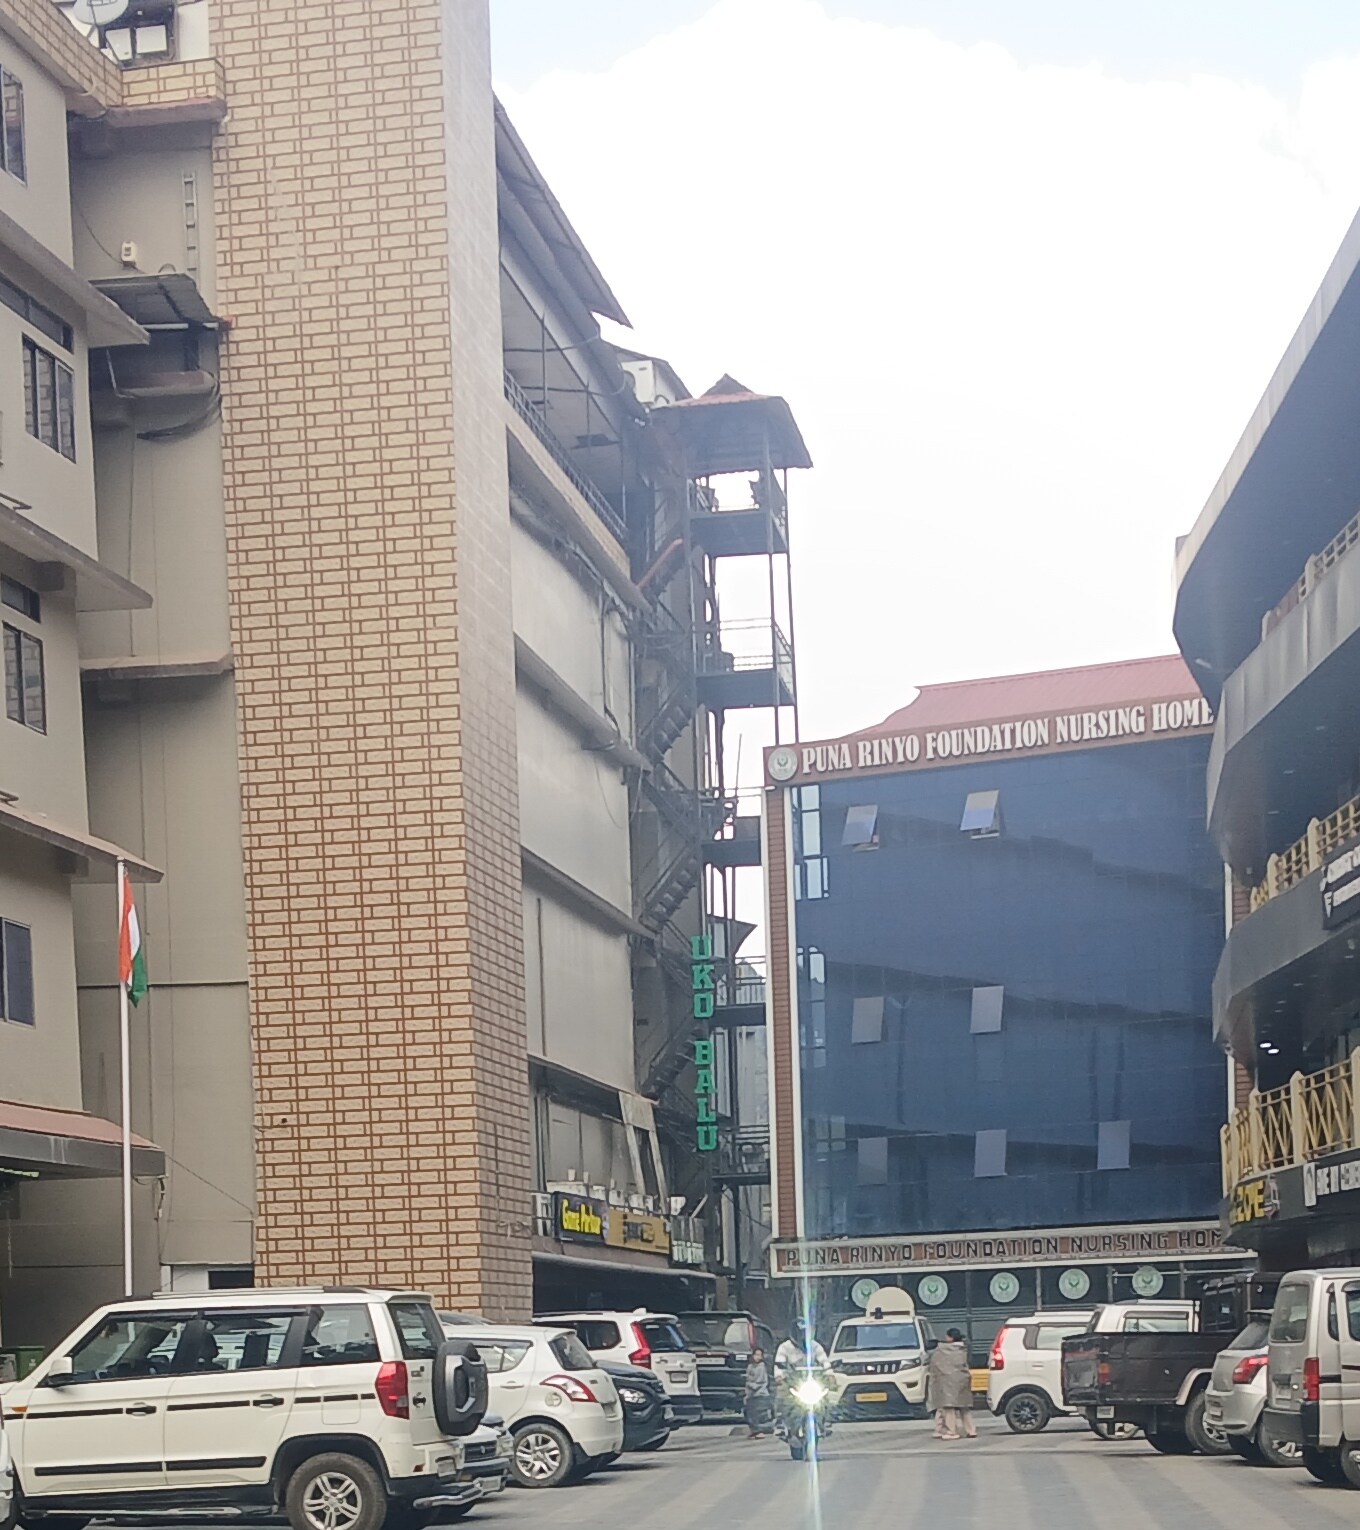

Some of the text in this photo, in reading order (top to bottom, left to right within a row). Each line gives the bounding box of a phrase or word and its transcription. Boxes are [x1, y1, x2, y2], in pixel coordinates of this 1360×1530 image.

[802, 698, 1213, 774] PUNA RINYO FOUNDATION NURSING HOME
[787, 1229, 1222, 1265] PUNA RINYO FOUNDATION NURSING HOM
